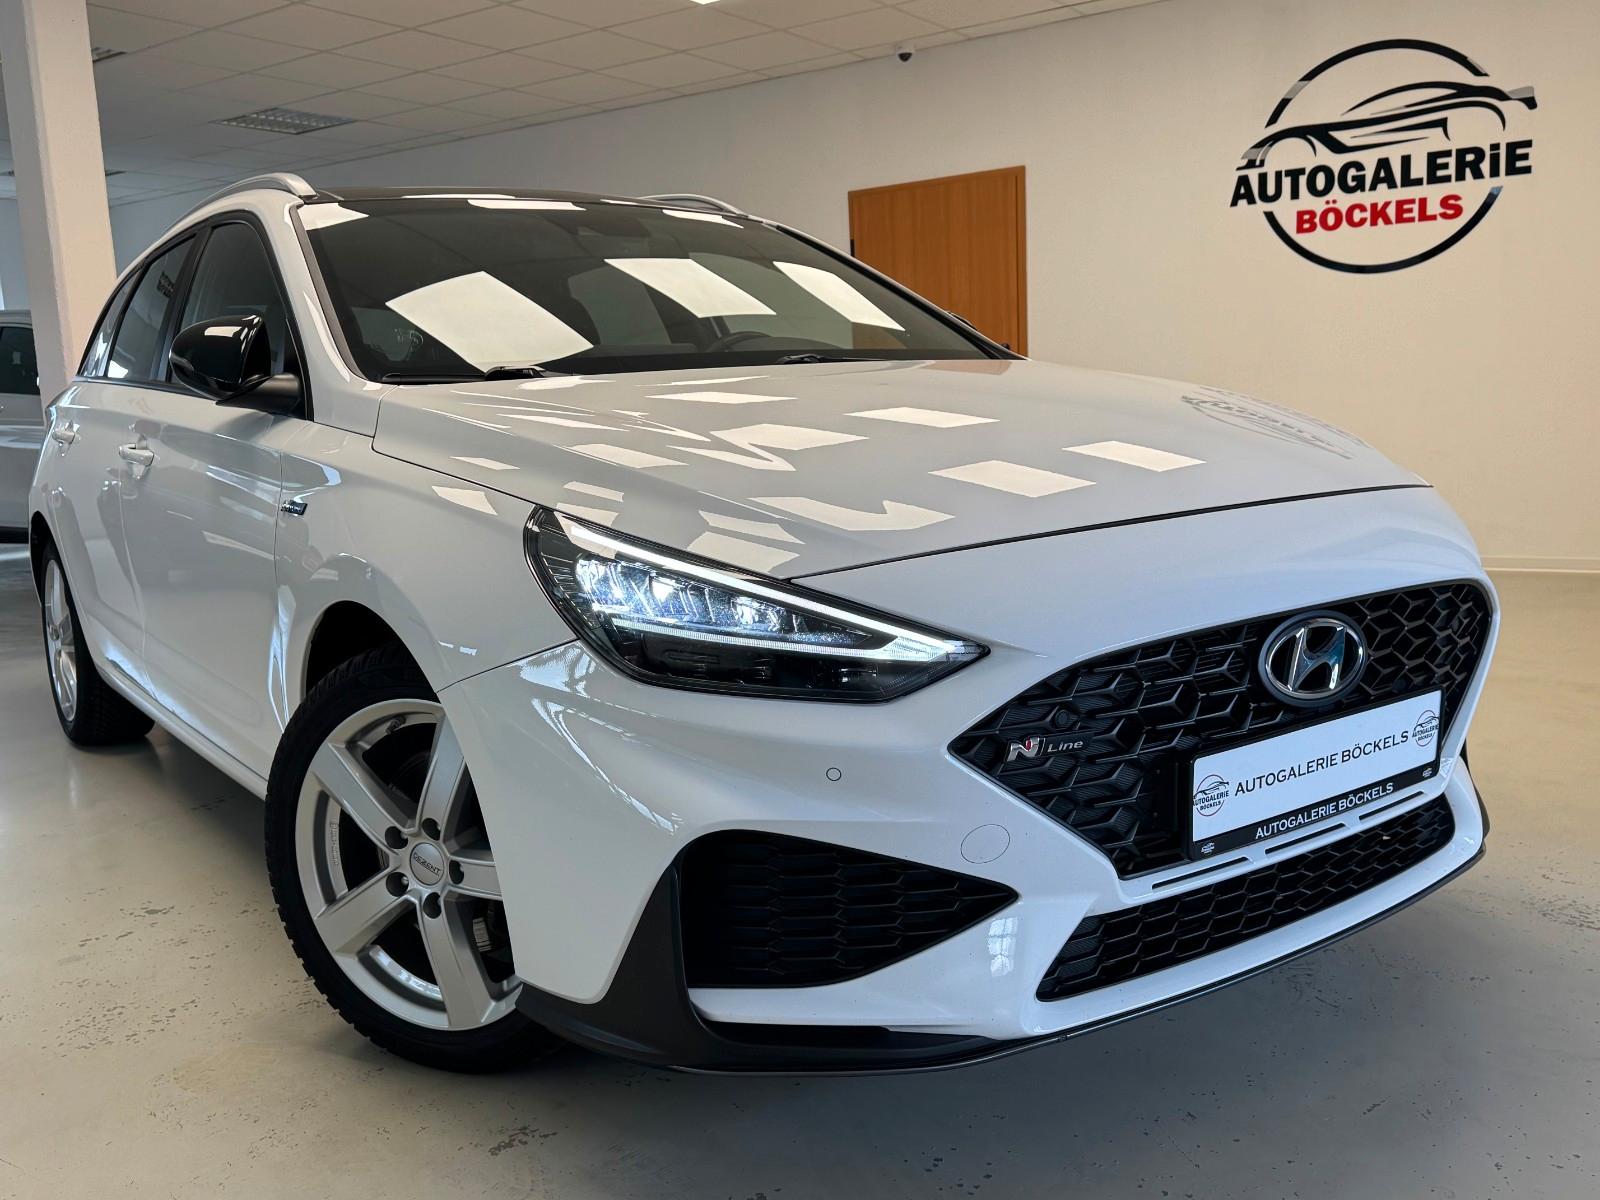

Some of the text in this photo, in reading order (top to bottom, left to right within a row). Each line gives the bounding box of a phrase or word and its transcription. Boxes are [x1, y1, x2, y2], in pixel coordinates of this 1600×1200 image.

[1296, 194, 1464, 234] BÖCKELS
[1047, 740, 1084, 753] Line
[1235, 731, 1408, 796] AUTOGALERIE BÖCKELS
[1255, 782, 1394, 839] AUTOGALERIE BÖCKELS
